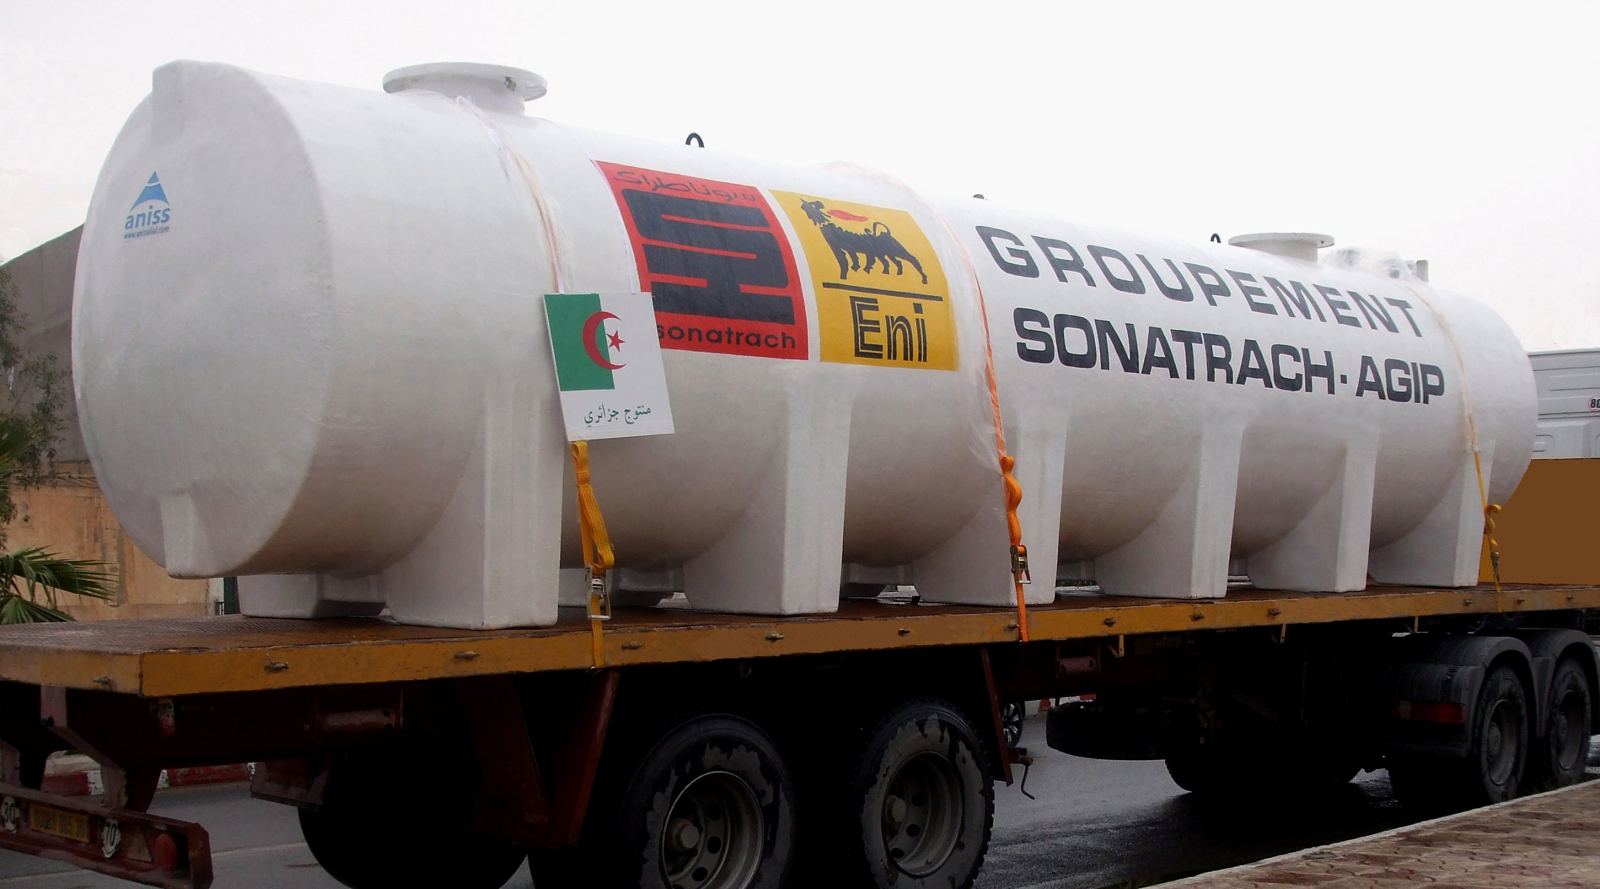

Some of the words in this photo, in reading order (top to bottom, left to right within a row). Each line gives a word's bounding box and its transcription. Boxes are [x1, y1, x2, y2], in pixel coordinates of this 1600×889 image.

[124, 205, 171, 230] aniss
[975, 225, 1424, 338] GROUPEMENT
[656, 324, 797, 349] sonatrach
[849, 295, 928, 363] Eni
[584, 403, 620, 428] جزائري
[623, 405, 652, 425] منتوج
